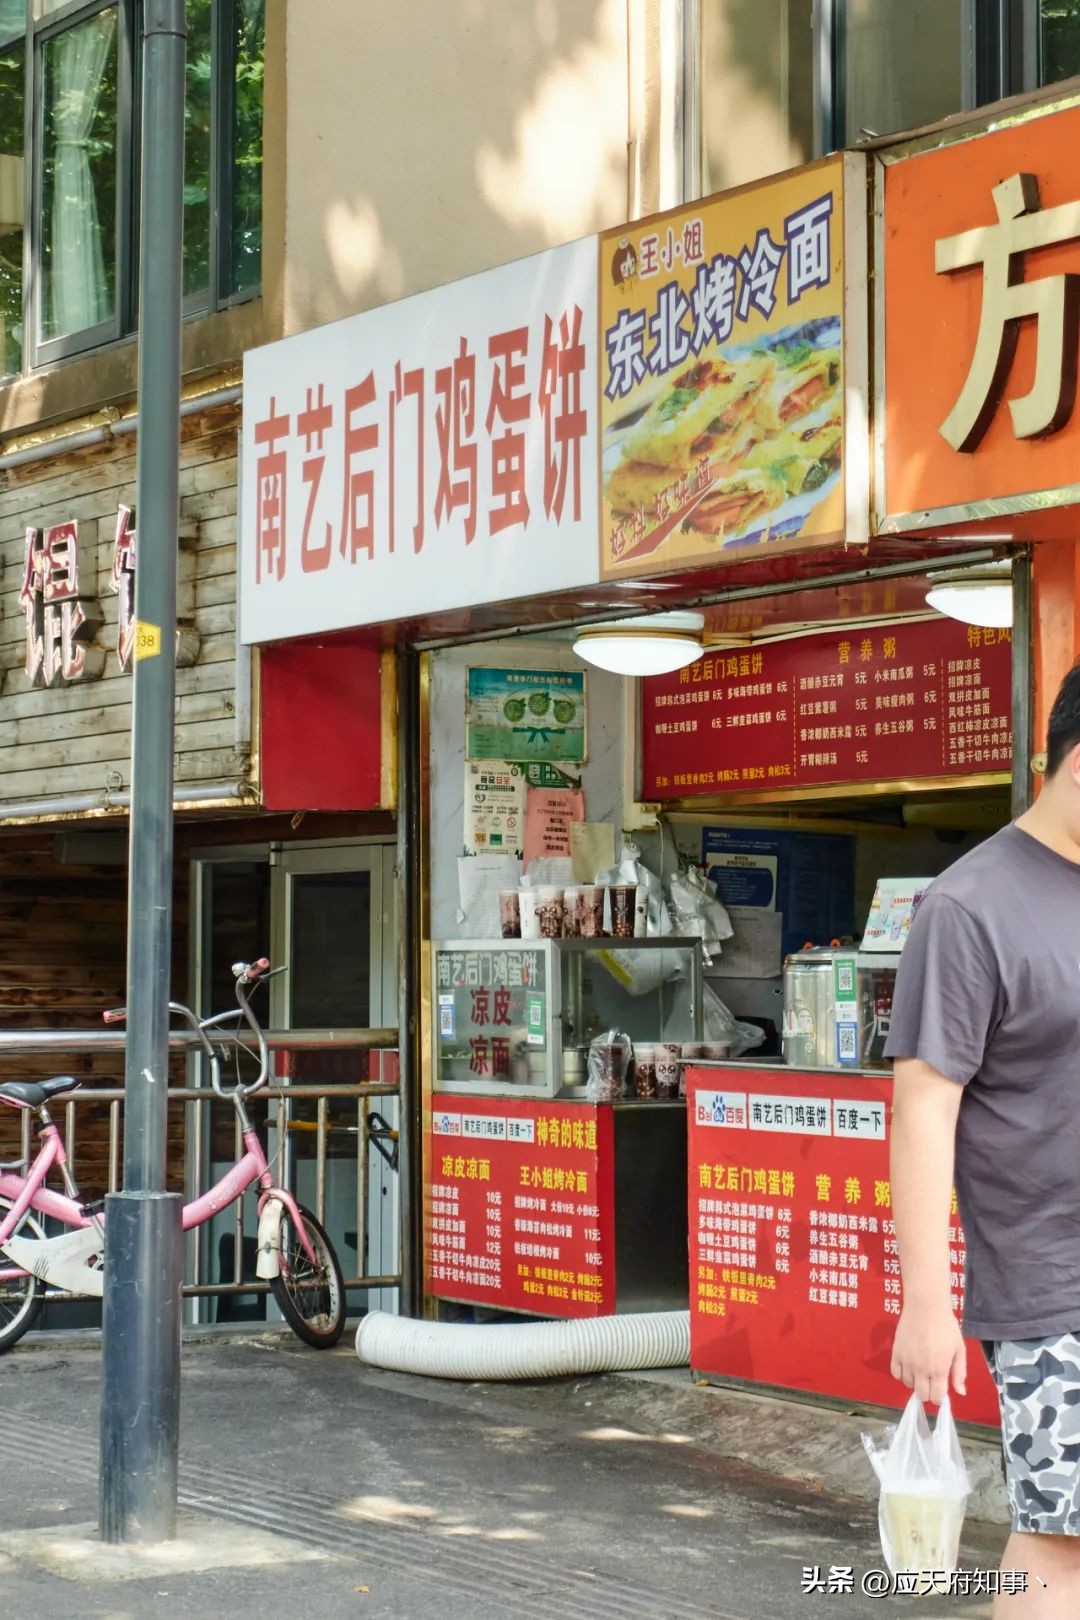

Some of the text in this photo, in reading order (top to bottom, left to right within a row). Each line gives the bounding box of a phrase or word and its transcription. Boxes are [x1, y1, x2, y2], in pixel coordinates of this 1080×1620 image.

[640, 218, 703, 277] 王小姐
[604, 192, 833, 400] 东北烤冷面
[935, 172, 1080, 453] 方
[254, 303, 588, 585] 南艺后门鸡蛋饼
[838, 636, 896, 664] 营养粥
[679, 652, 763, 684] 南艺后门鸡蛋饼
[855, 671, 867, 684] 5元
[874, 666, 914, 683] 小米南瓜粥
[923, 663, 936, 676] 5元
[948, 657, 981, 673] 招牌凉皮
[712, 689, 722, 700] 6元
[777, 681, 788, 692] 6元
[948, 673, 981, 688] 招牌凉面
[800, 690, 937, 715] 红豆紫薯粥 5元 美味瘦肉粥 6元
[948, 687, 990, 703] 双拼皮加面
[711, 717, 722, 729] 6元
[776, 710, 787, 721] 6元
[948, 703, 990, 719] 风味牛筋面
[855, 724, 867, 737] 5元
[875, 719, 914, 736] 养生五谷粥
[923, 717, 936, 730] 5元
[949, 716, 1008, 733] 西红柿凉皮凉面
[856, 750, 868, 763] 5元
[437, 951, 538, 987] 南艺后门鸡蛋饼
[470, 985, 512, 1026] 凉皮
[469, 1035, 512, 1076] 凉面
[753, 1102, 826, 1128] 南艺后门鸡蛋饼
[837, 1108, 881, 1131] 百度一下
[537, 1116, 598, 1150] 神奇的味道
[442, 1155, 491, 1181] 凉皮凉面
[520, 1166, 588, 1193] 王小姐烤冷面
[699, 1163, 795, 1198] 南艺后门鸡蛋饼
[486, 1191, 502, 1205] 10元
[815, 1174, 890, 1208] 营养粥
[486, 1208, 502, 1221] 10元
[699, 1199, 792, 1222] 招牌韩式泡菜鸡蛋饼 6元
[809, 1210, 896, 1235] 香浓椰奶西米露 5元
[486, 1225, 502, 1239] 10元
[698, 1215, 790, 1239] 多味海带鸡蛋饼 6元
[486, 1241, 502, 1255] 12元
[776, 1242, 790, 1256] 6元
[809, 1230, 899, 1255] 养生五谷粥 5元
[775, 1260, 790, 1274] 6元
[809, 1249, 900, 1275] 酒酿赤豆元宵 5元
[809, 1268, 901, 1295] 小米南瓜粥 5元
[809, 1287, 901, 1315] 红豆紫薯粥 5元
